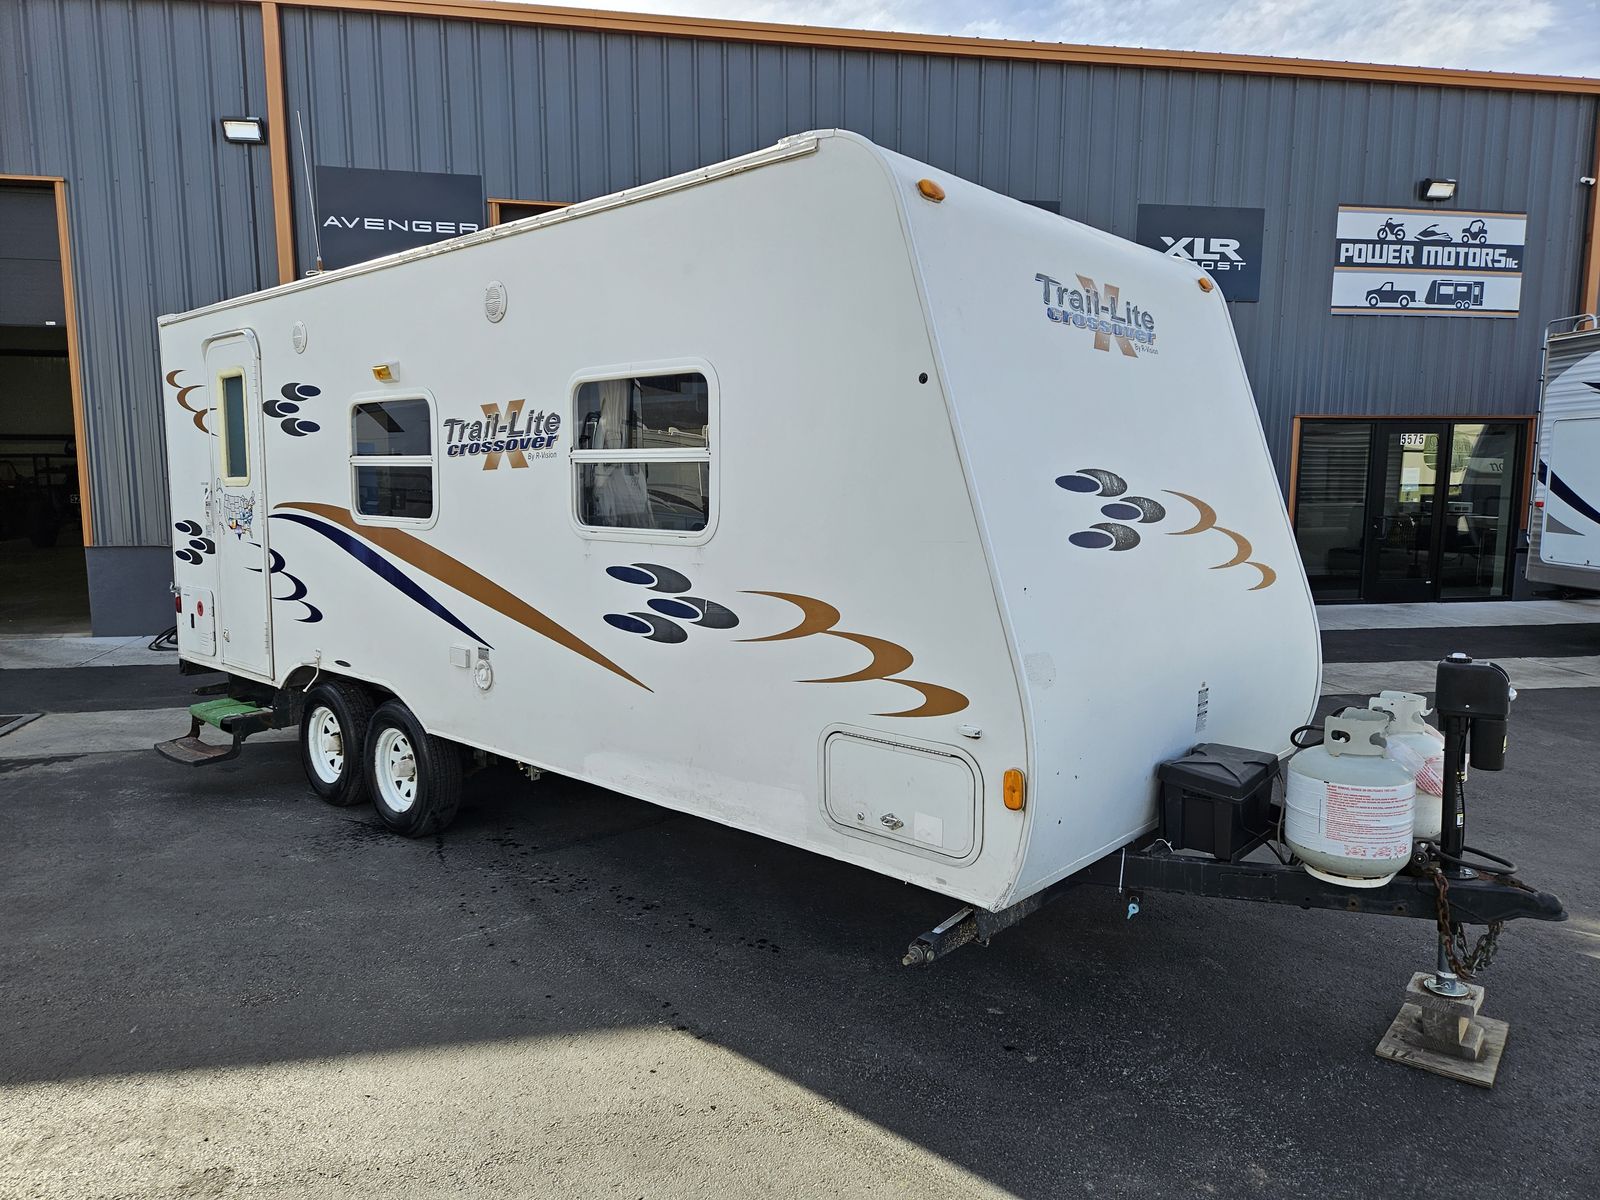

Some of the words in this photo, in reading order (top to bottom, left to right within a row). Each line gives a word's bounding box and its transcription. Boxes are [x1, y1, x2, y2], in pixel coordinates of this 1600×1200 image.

[323, 215, 479, 234] AVENGER
[1160, 236, 1243, 261] XLR
[1339, 243, 1414, 265] POWER
[1421, 245, 1506, 268] MOTORS
[1035, 273, 1155, 331] Trail-Lite
[1047, 307, 1156, 345] crossover
[443, 410, 561, 444] Trail-Lite
[1401, 434, 1424, 445] 5575
[447, 434, 559, 457] crossover
